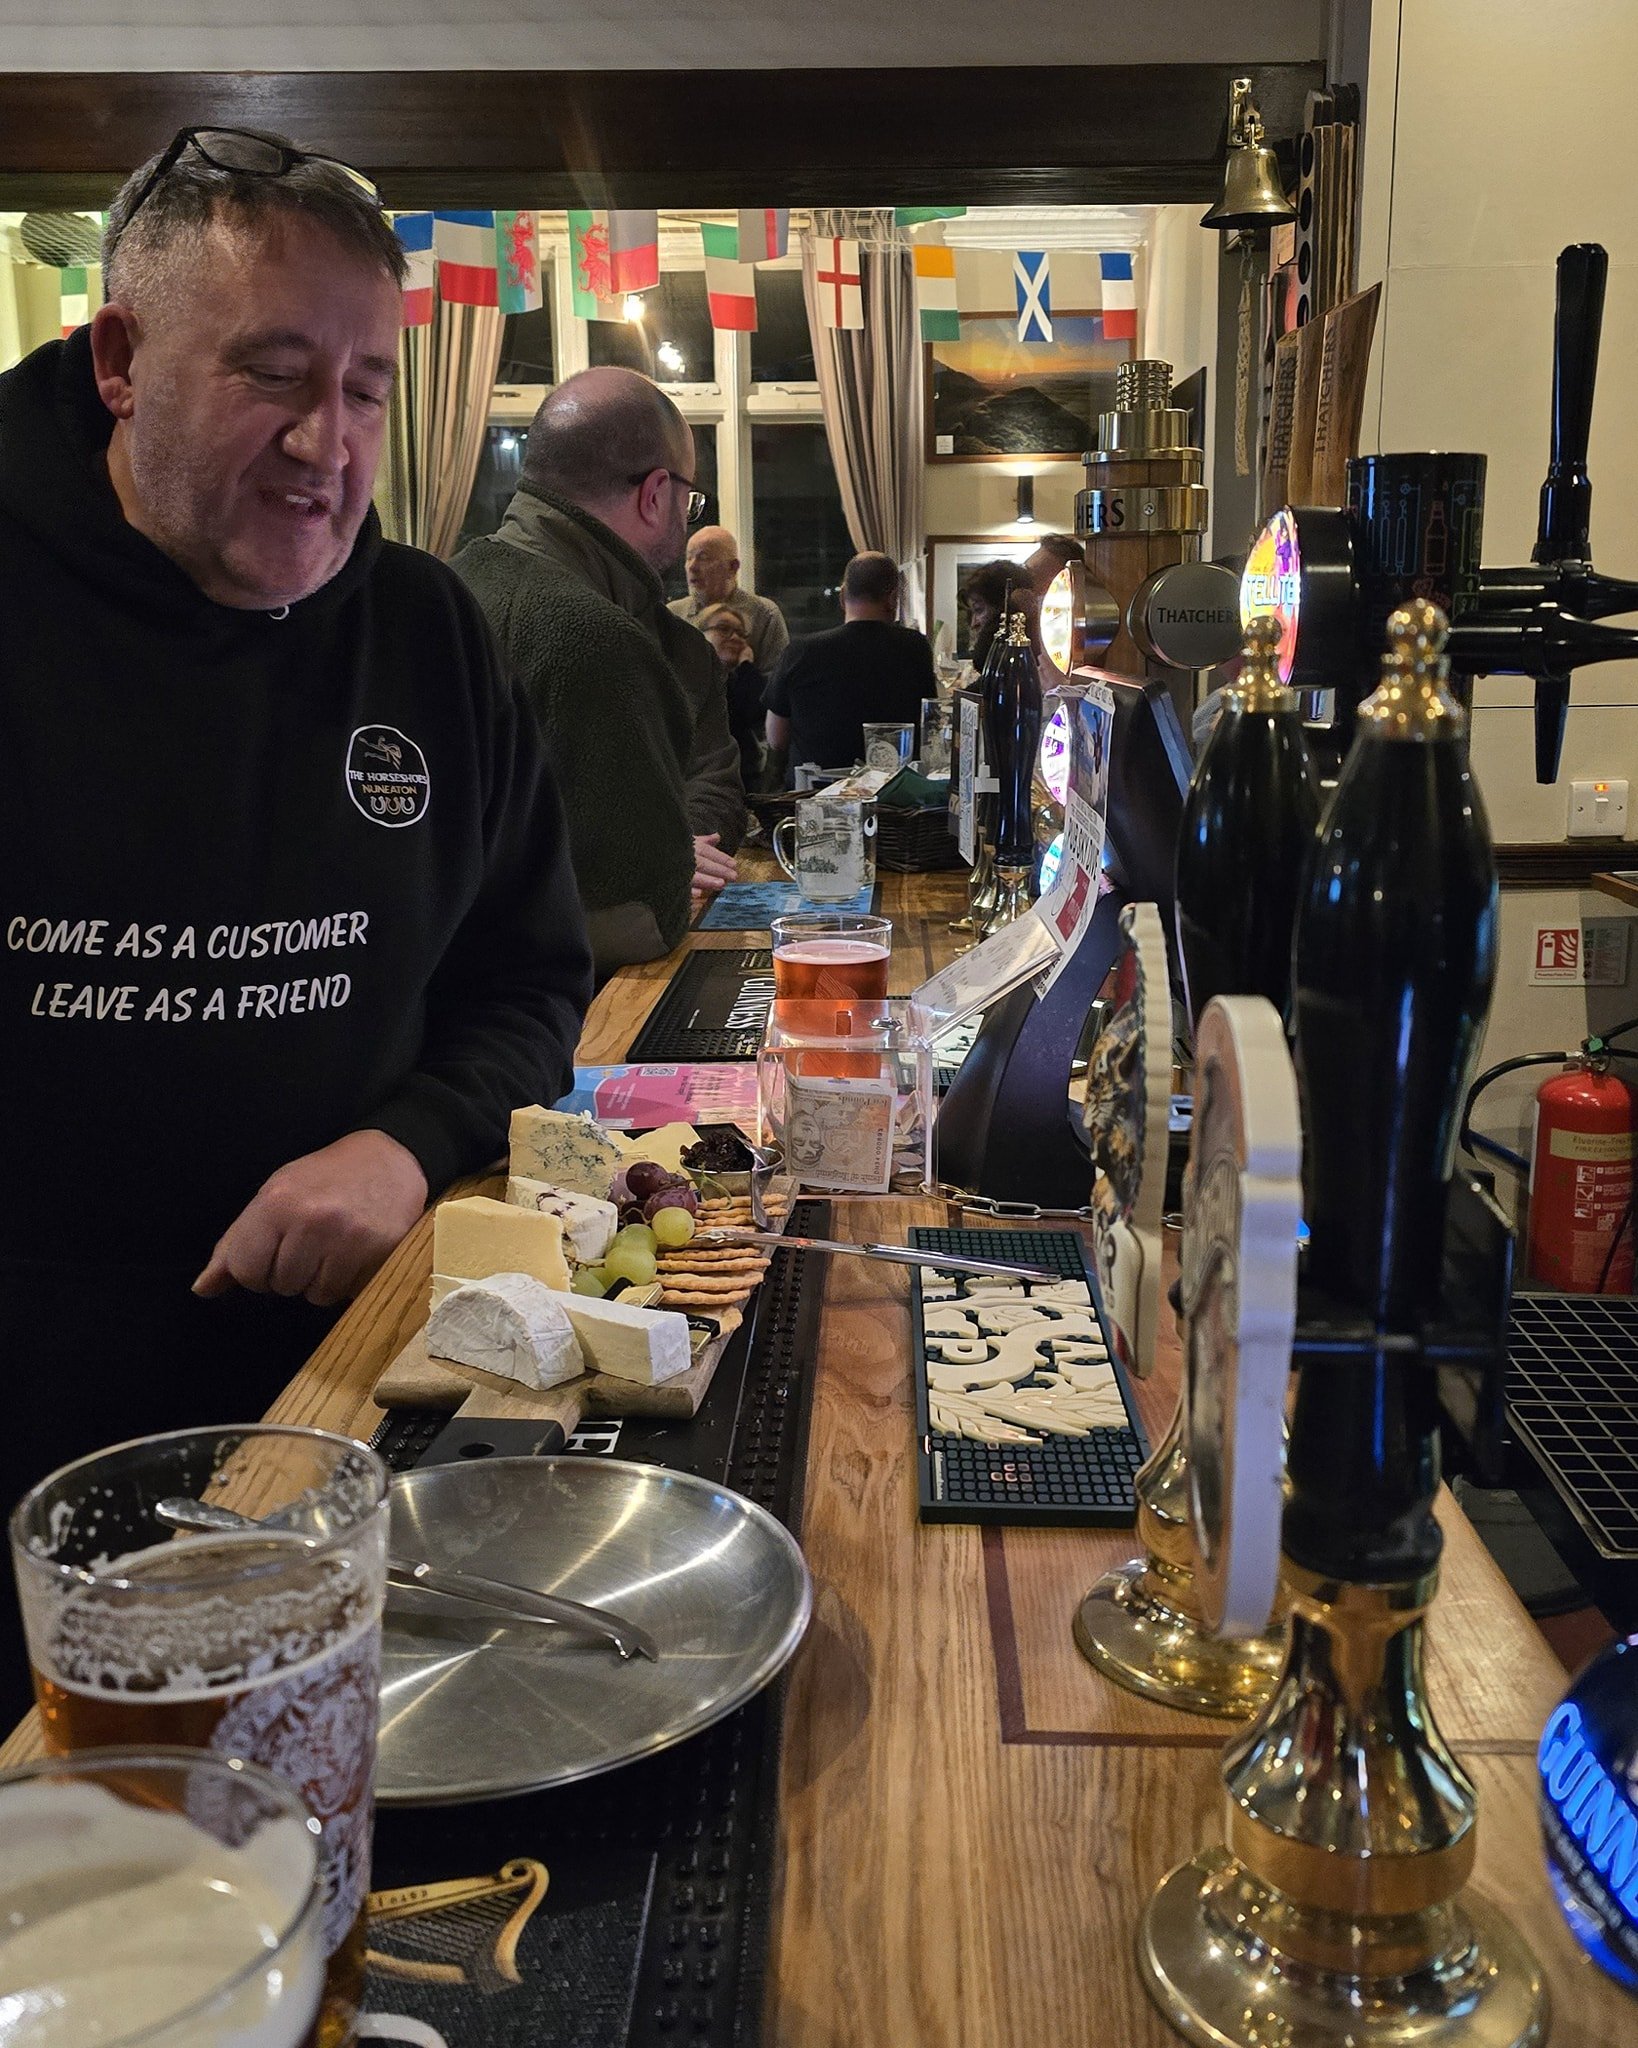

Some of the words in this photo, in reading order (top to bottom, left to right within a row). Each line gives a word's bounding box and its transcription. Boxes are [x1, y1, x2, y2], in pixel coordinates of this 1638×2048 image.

[1271, 357, 1297, 471] THATCHERS
[1316, 328, 1337, 453] THATCHERS
[1157, 607, 1235, 624] THATCHER
[349, 770, 365, 781] THE
[366, 772, 428, 785] HORSESHOES
[362, 784, 418, 794] NUNEATON
[7, 916, 109, 956] COME
[114, 923, 166, 959] AS
[171, 925, 196, 959] A
[207, 911, 369, 960] CUSTOMER
[31, 983, 139, 1021] LEAVE
[144, 987, 197, 1022] AS
[202, 987, 225, 1021] A
[237, 973, 352, 1019] FRIEND
[724, 977, 776, 1029] GUINNESS
